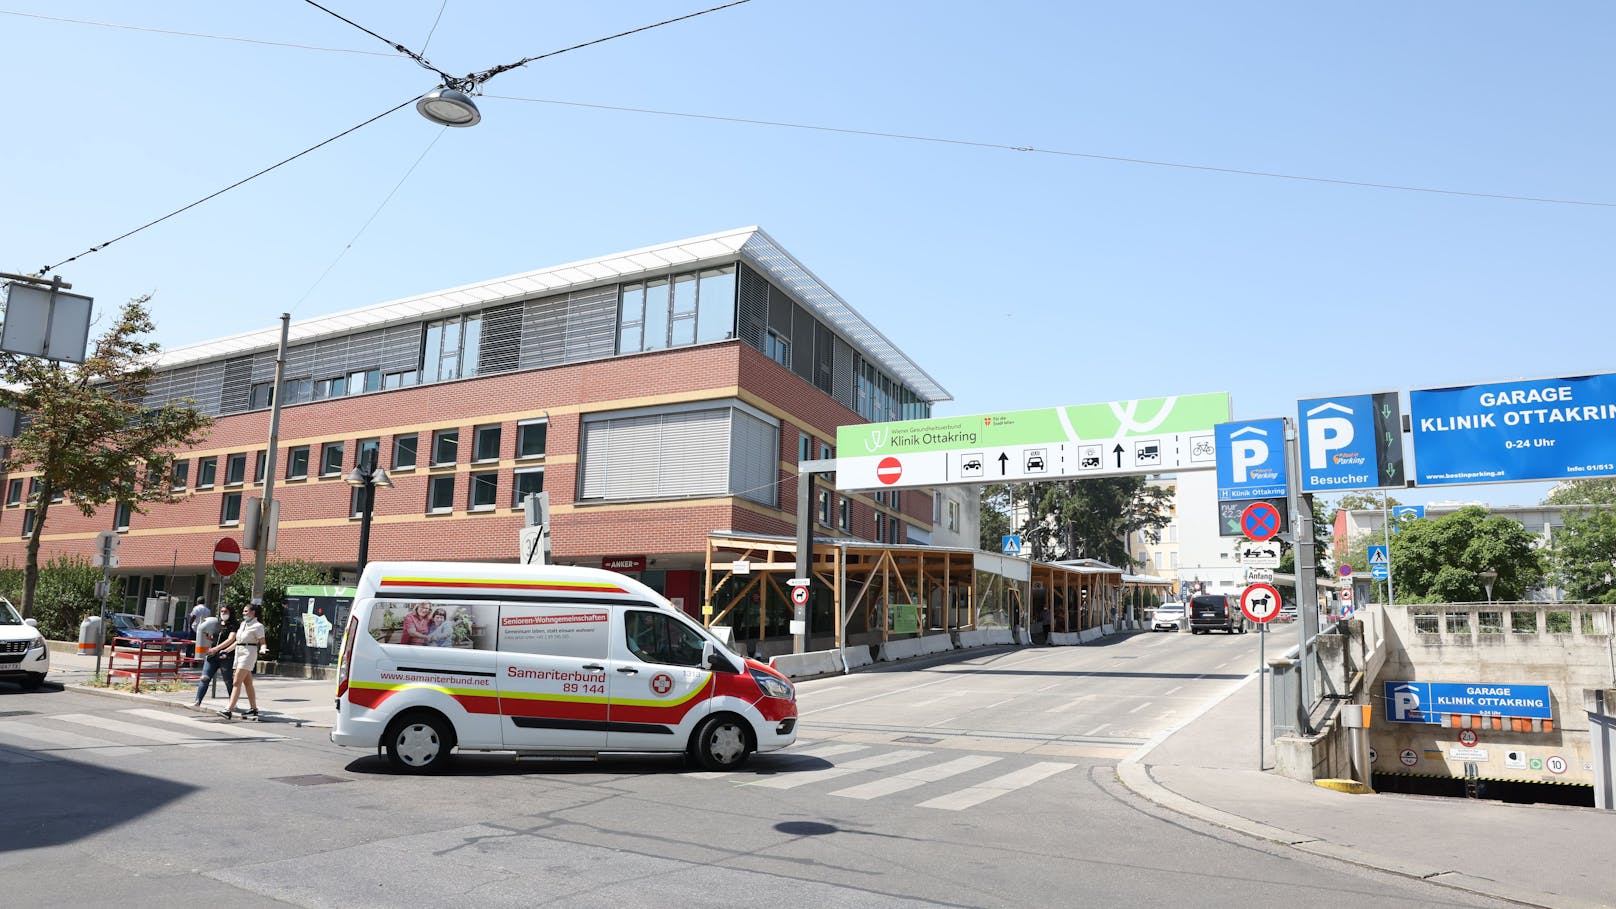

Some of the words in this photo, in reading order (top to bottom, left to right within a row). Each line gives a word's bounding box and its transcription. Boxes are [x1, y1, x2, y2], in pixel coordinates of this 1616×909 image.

[1480, 386, 1572, 406] GARAGE
[910, 424, 962, 432] Gesundheitsverbund
[1421, 413, 1496, 432] KLINIK
[891, 435, 919, 446] Klinik
[922, 432, 977, 444] Ottakring
[1307, 417, 1354, 469] P
[1505, 440, 1530, 449] 0-24
[1534, 439, 1556, 447] Uhr
[1232, 440, 1268, 483] P
[1310, 474, 1368, 485] Besucher
[1426, 470, 1504, 480] www.bestinparking.at
[1249, 572, 1272, 580] Anfang
[504, 614, 606, 625] Senioren-Wohngemeinschaften
[380, 672, 489, 685] www.samariterbund.net
[508, 666, 606, 682] Samariterbund
[563, 684, 578, 692] 89
[583, 684, 604, 694] 144
[1467, 688, 1511, 696] GARAGE
[1438, 697, 1475, 705] KLINIK
[1478, 697, 1543, 707] OTTAKRING
[1552, 760, 1562, 769] 10
